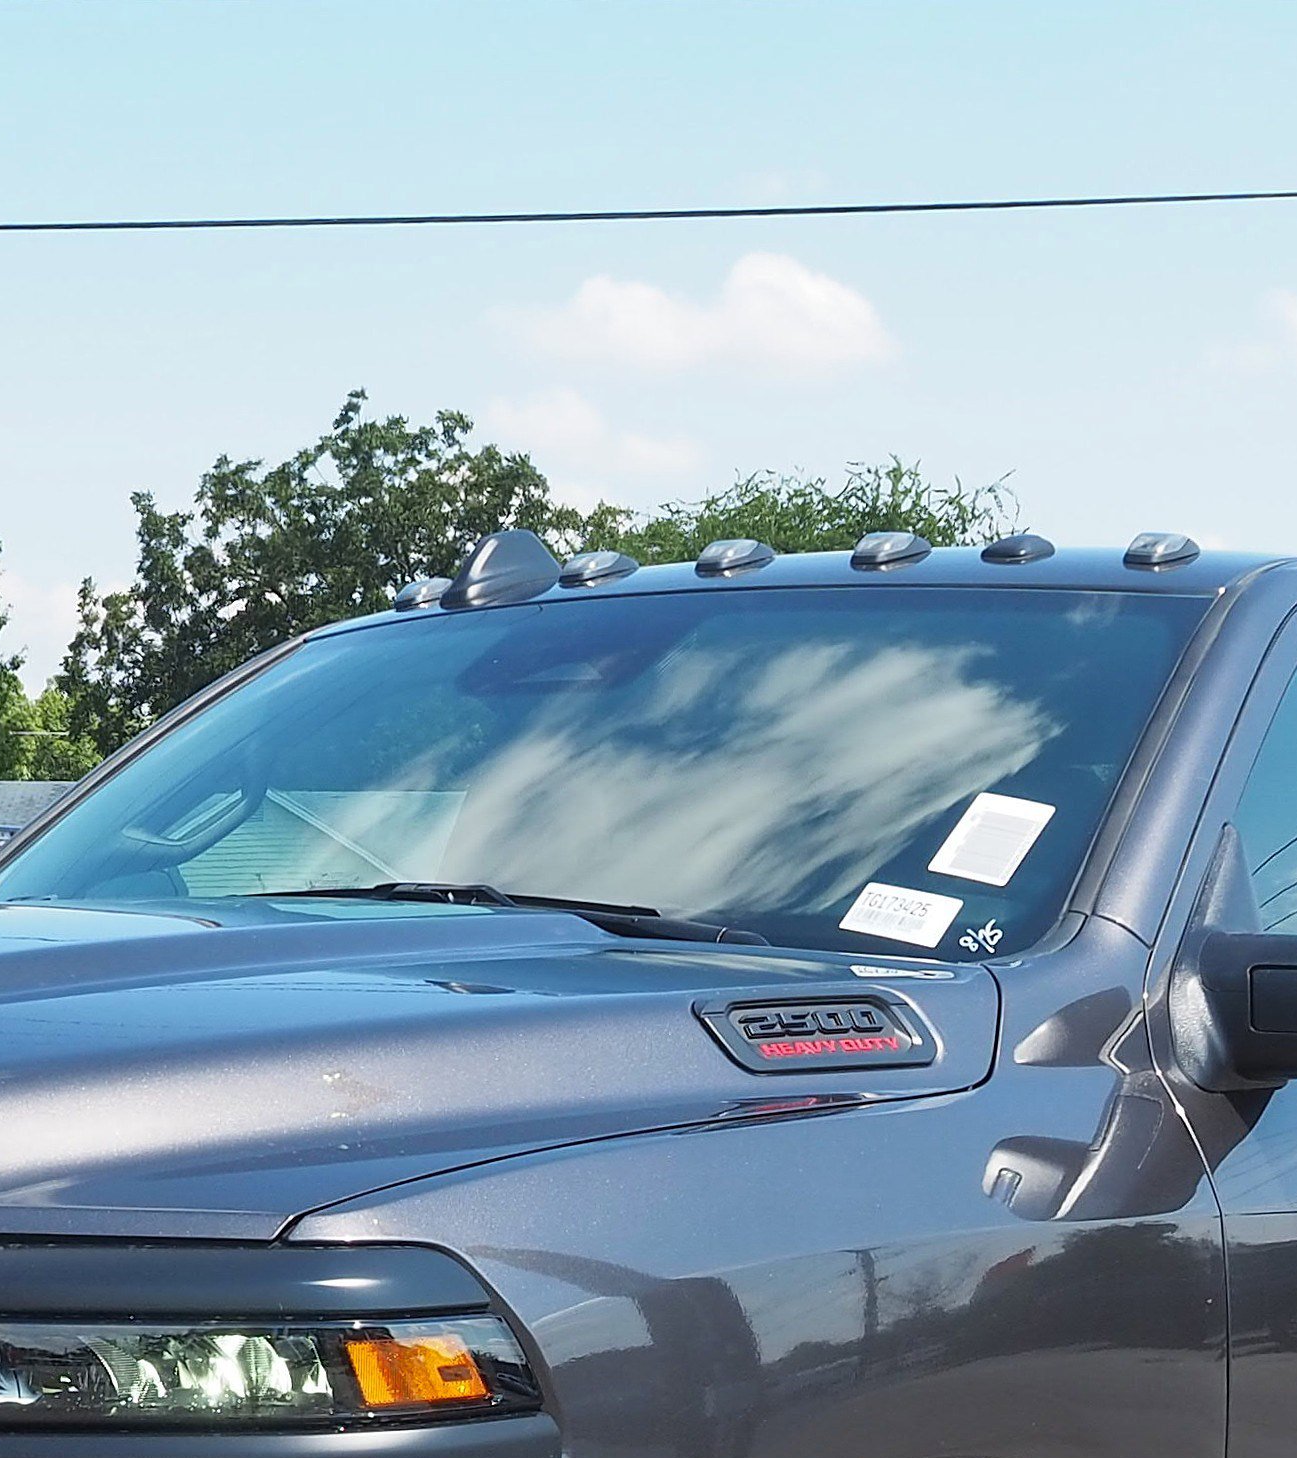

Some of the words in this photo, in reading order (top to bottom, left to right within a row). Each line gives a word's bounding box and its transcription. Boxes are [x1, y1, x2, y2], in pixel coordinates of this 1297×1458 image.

[738, 1009, 884, 1039] 2500
[760, 1040, 837, 1058] HEAVY
[839, 1037, 900, 1053] DUTY
